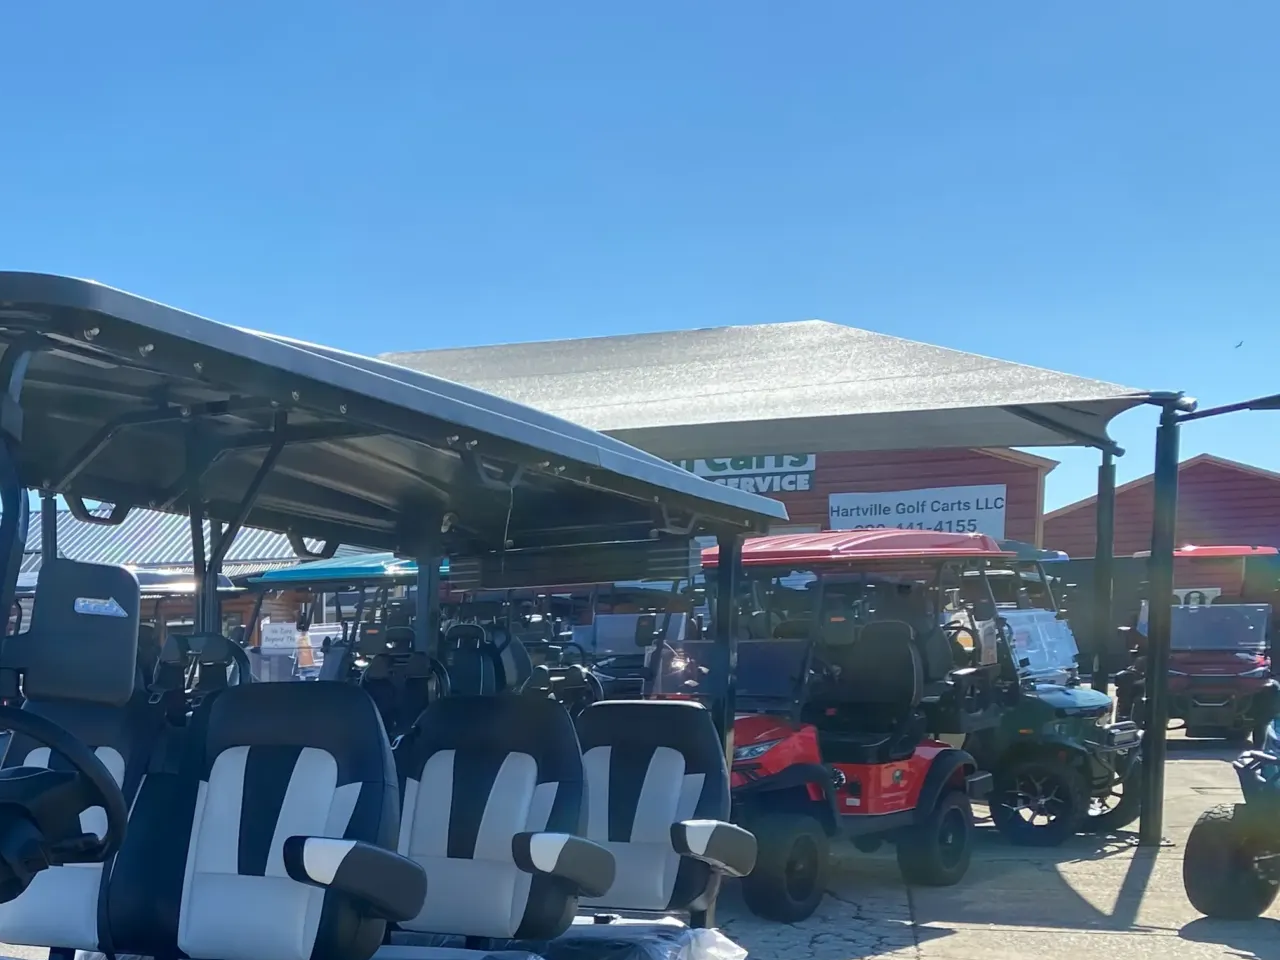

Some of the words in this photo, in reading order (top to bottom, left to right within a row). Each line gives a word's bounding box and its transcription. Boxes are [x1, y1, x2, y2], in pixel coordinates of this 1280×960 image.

[830, 504, 891, 517] Hartville
[895, 501, 927, 515] Golf
[930, 500, 971, 512] Carts
[976, 497, 1005, 510] LLC
